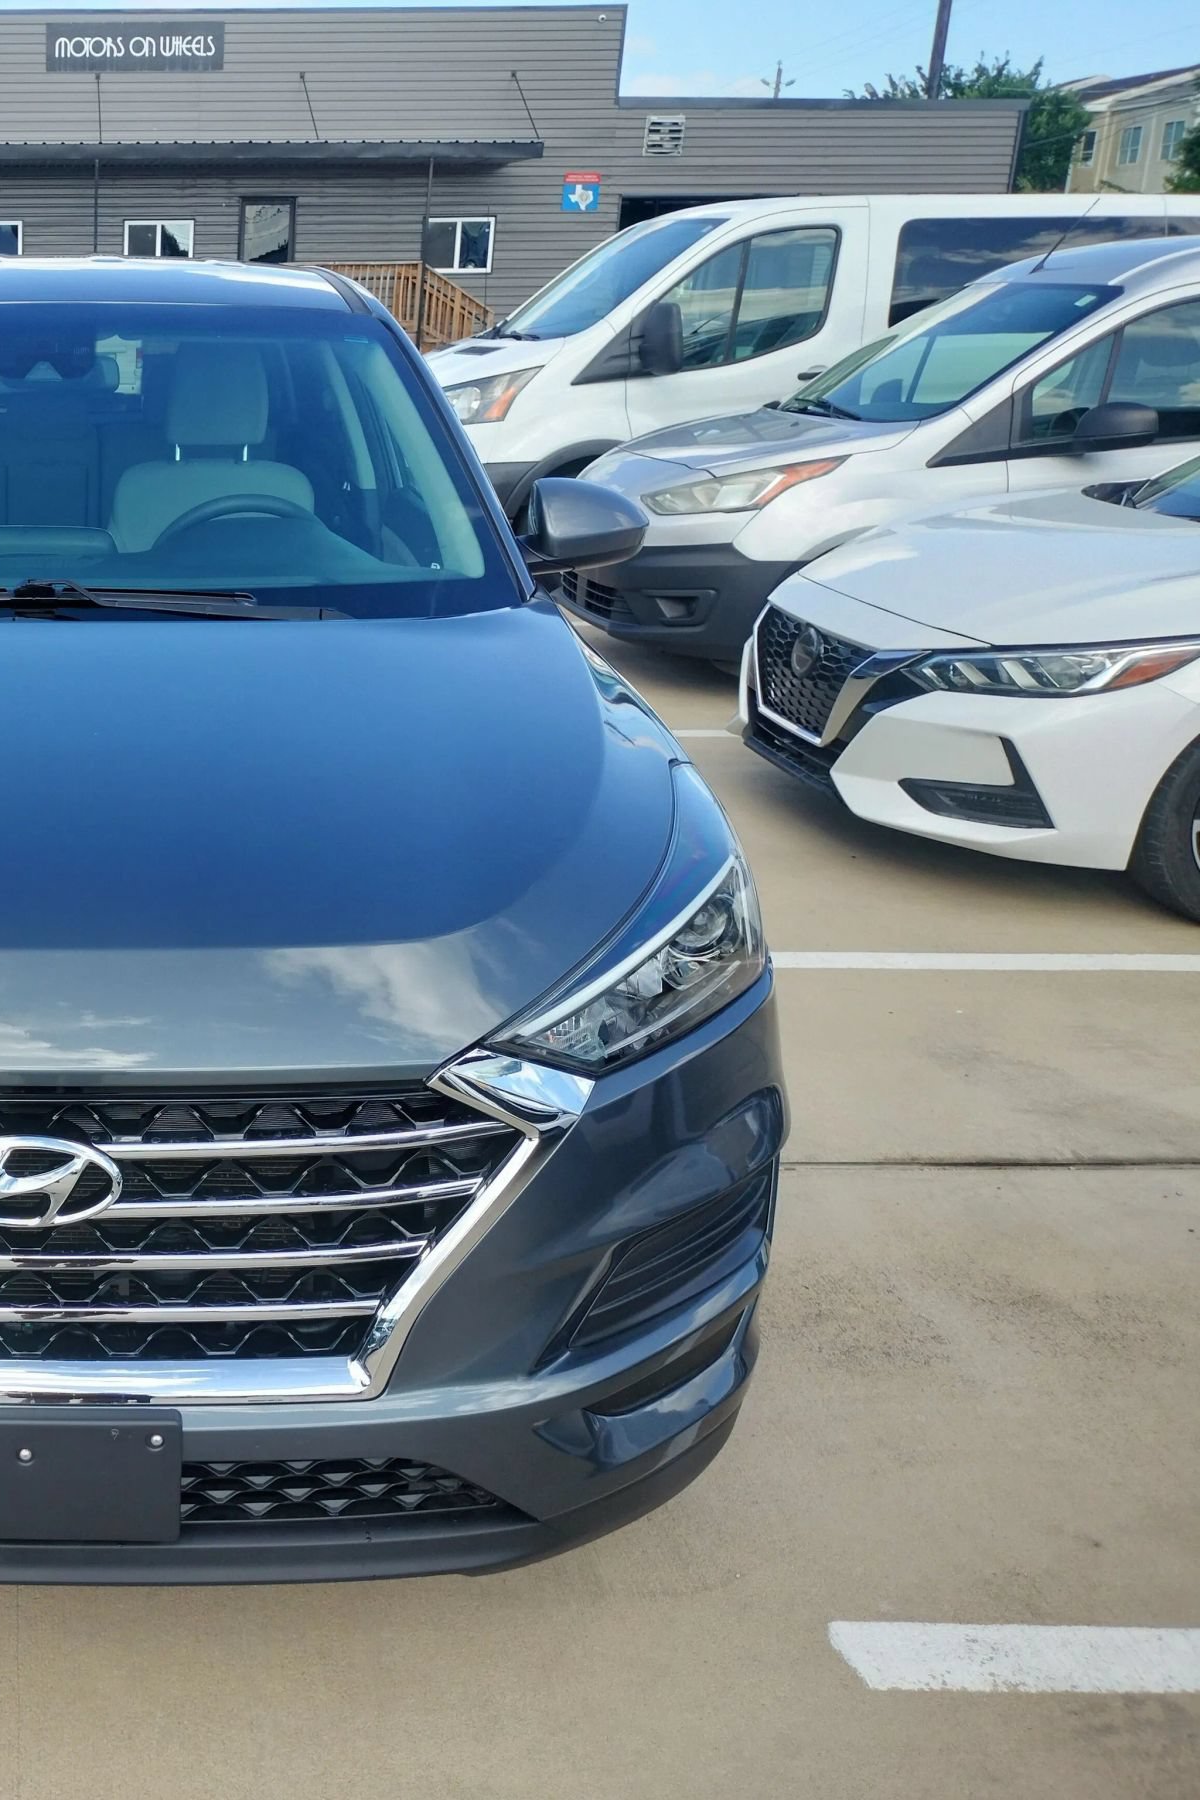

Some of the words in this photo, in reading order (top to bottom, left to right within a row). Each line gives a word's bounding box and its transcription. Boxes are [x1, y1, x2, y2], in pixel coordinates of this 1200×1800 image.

[55, 37, 125, 57] MOTORS
[129, 37, 156, 57] ON
[159, 36, 216, 56] WHEELS
